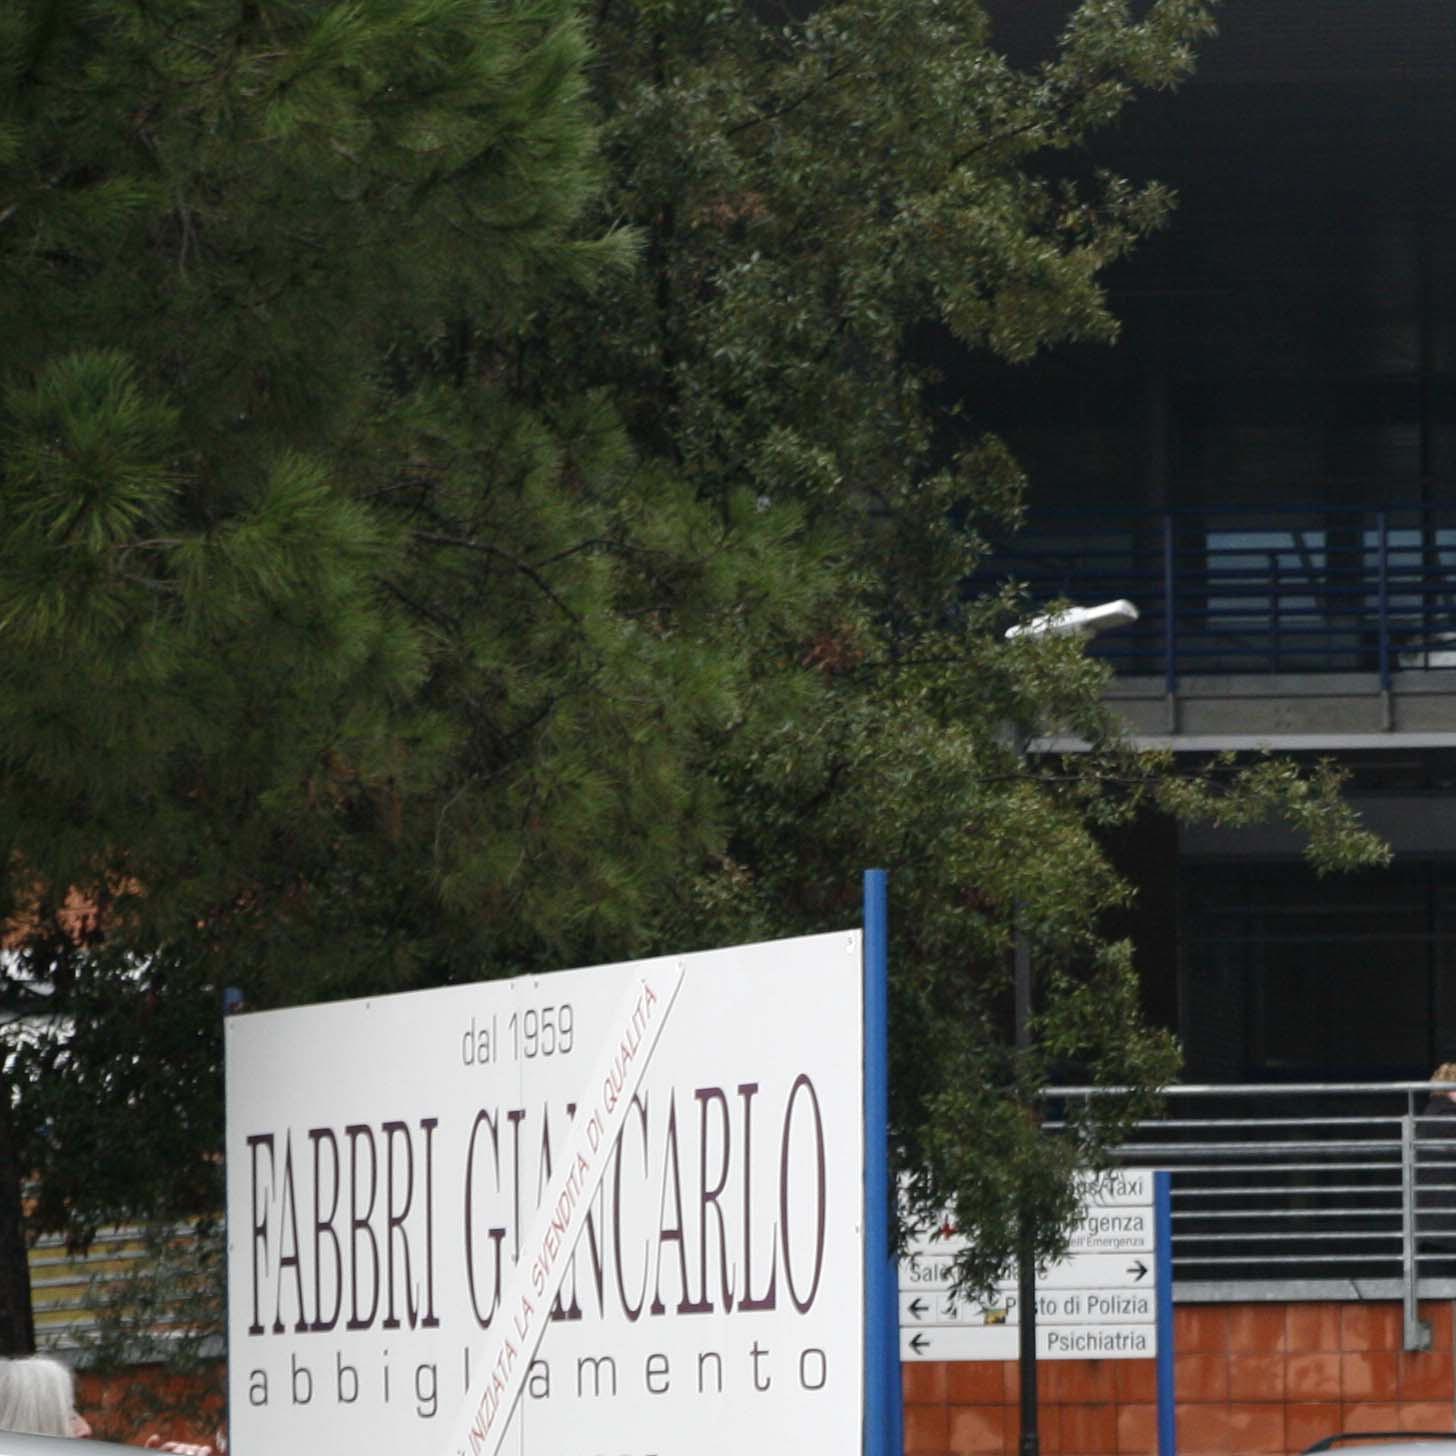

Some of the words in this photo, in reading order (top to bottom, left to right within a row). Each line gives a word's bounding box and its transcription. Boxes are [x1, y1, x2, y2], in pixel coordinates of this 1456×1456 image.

[463, 1012, 497, 1066] dal
[509, 1003, 575, 1061] 1959
[247, 1118, 439, 1337] FABBRI
[513, 1294, 535, 1342] LA
[530, 1152, 590, 1298] SVENDITA
[585, 1109, 605, 1155] DI
[1006, 1297, 1057, 1315] Pto
[1064, 1296, 1081, 1315] di
[1087, 1295, 1149, 1316] Polizia
[1047, 1331, 1147, 1352] Psichiatria
[248, 1342, 829, 1418] abbiglamento
